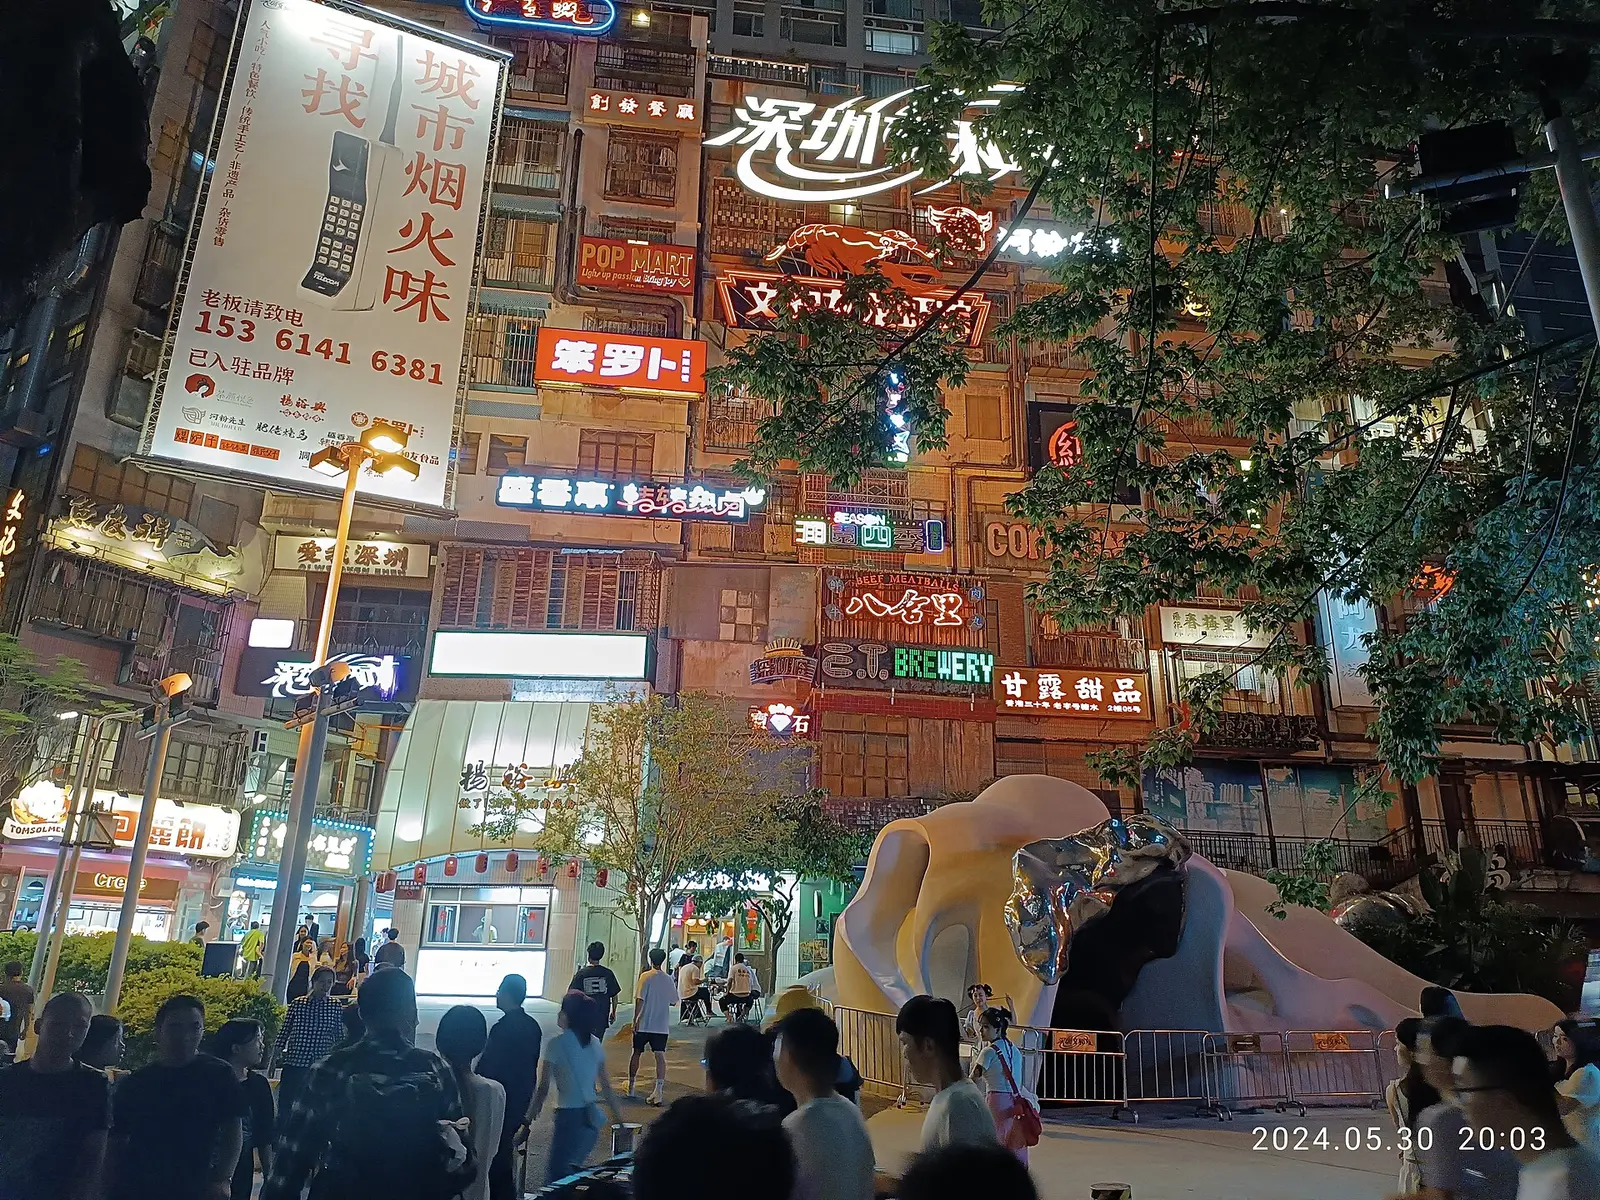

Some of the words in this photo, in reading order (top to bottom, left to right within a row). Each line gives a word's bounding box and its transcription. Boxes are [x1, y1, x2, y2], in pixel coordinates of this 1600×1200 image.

[300, 18, 381, 129] 寻找
[382, 49, 482, 324] 城市烟火味
[581, 243, 625, 270] POP
[631, 247, 694, 277] MART
[200, 289, 304, 328] 老板请致电
[194, 310, 257, 343] 153
[274, 328, 352, 365] 6141
[370, 349, 444, 386] 6381
[856, 575, 884, 586] BEEF
[889, 576, 960, 593] MEATBALLS
[893, 647, 994, 683] BREWERY
[1000, 671, 1143, 704] 甘露甜品
